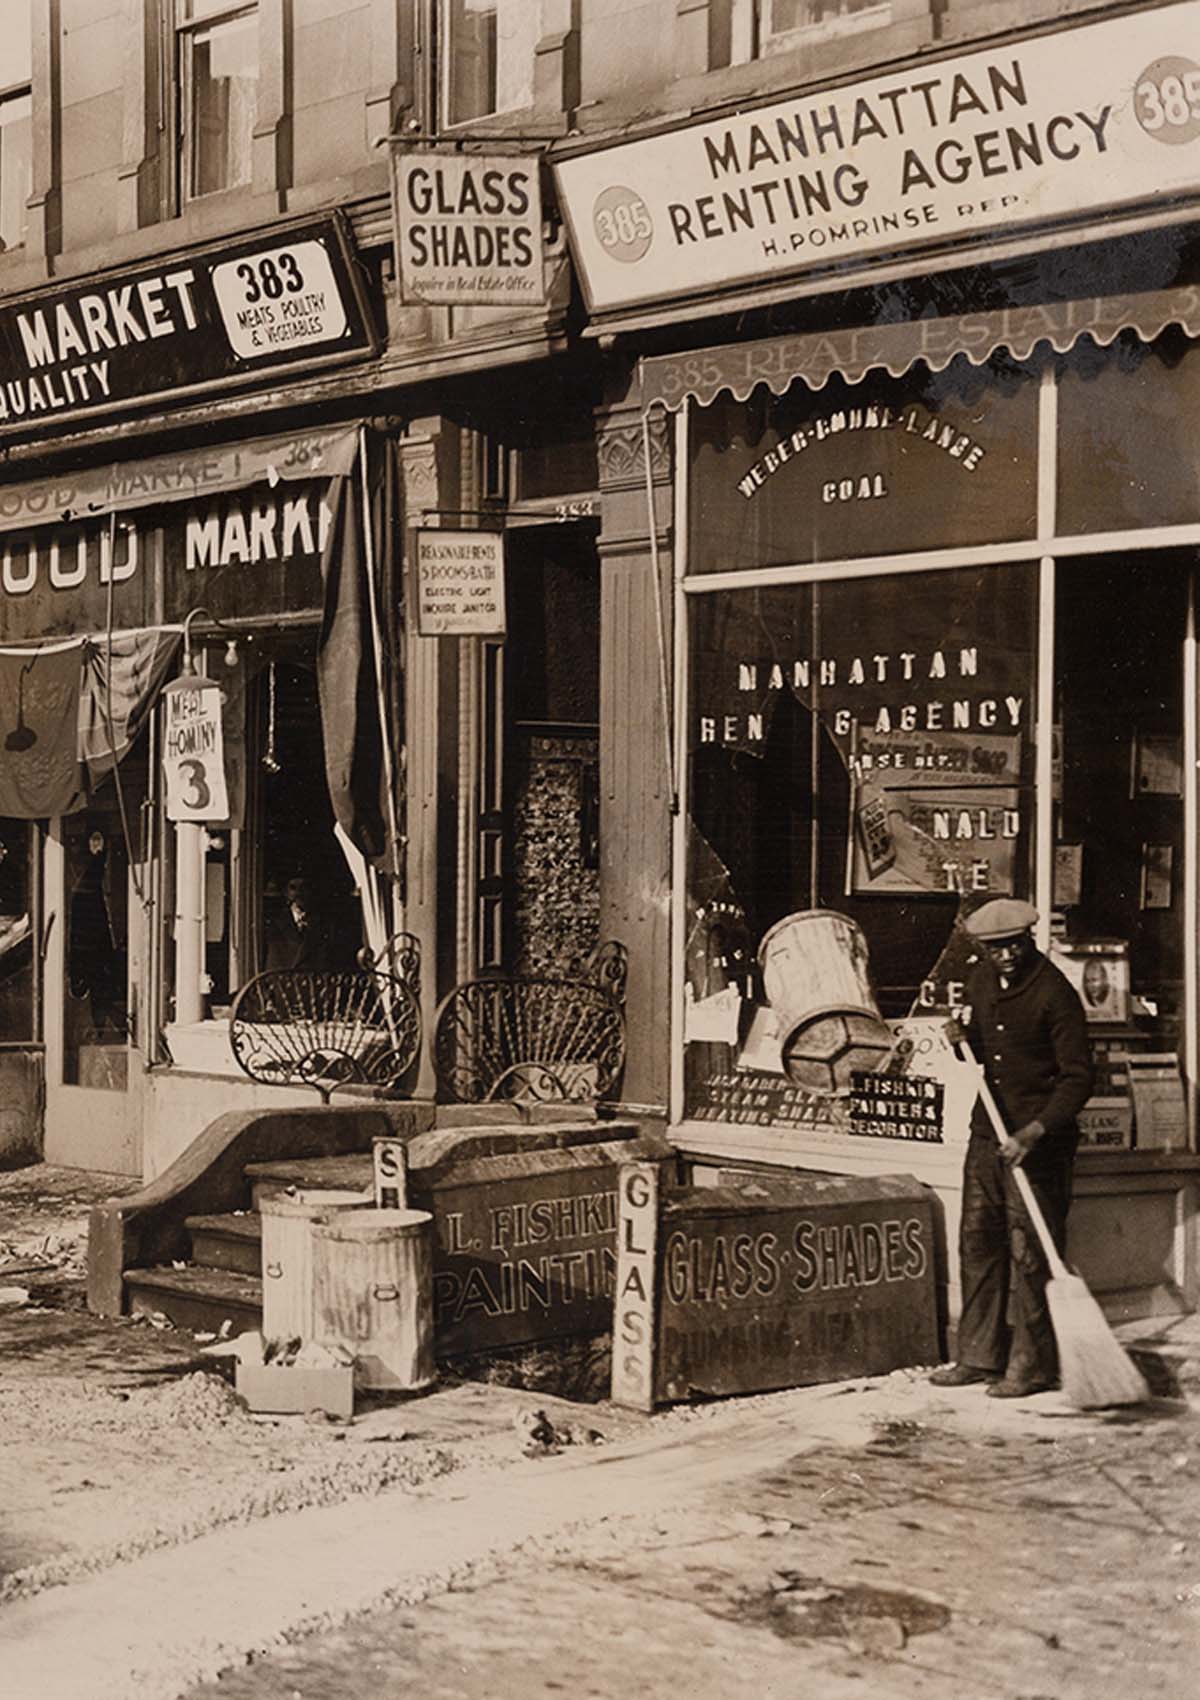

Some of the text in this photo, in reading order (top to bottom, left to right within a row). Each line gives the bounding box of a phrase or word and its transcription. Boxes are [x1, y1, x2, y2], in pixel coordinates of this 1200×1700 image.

[703, 60, 1028, 180] MANHATTAN
[408, 168, 529, 215] GLASS
[668, 106, 1113, 246] RENTING AGENCY
[594, 201, 654, 246] 385
[409, 225, 532, 267] SHADES
[237, 253, 304, 303] 383
[506, 276, 535, 291] Office
[17, 271, 201, 367] MARKET
[237, 292, 326, 330] MEATS POULTRY
[251, 316, 323, 347] & VEGETABLES
[660, 358, 723, 395] 385
[744, 334, 872, 379] REAL
[919, 299, 1129, 352] ESTATE
[823, 475, 888, 503] COAL
[186, 494, 331, 571] MARK
[738, 648, 979, 691] MANHATTAN
[875, 696, 1023, 734] AGENCY
[167, 720, 217, 759] HOMINY
[178, 758, 211, 810] 3
[932, 810, 1020, 840] NALD
[694, 1106, 769, 1125] HEATING
[710, 1089, 769, 1107] STEAM
[778, 1104, 830, 1122] SHAD
[783, 1088, 818, 1105] GLA
[851, 1099, 923, 1119] PAINTER
[446, 1190, 617, 1256] L. FISHKI
[622, 1173, 651, 1393] GLASS
[665, 1219, 928, 1306] GLASS SHADES
[432, 1247, 617, 1325] PAINTIN
